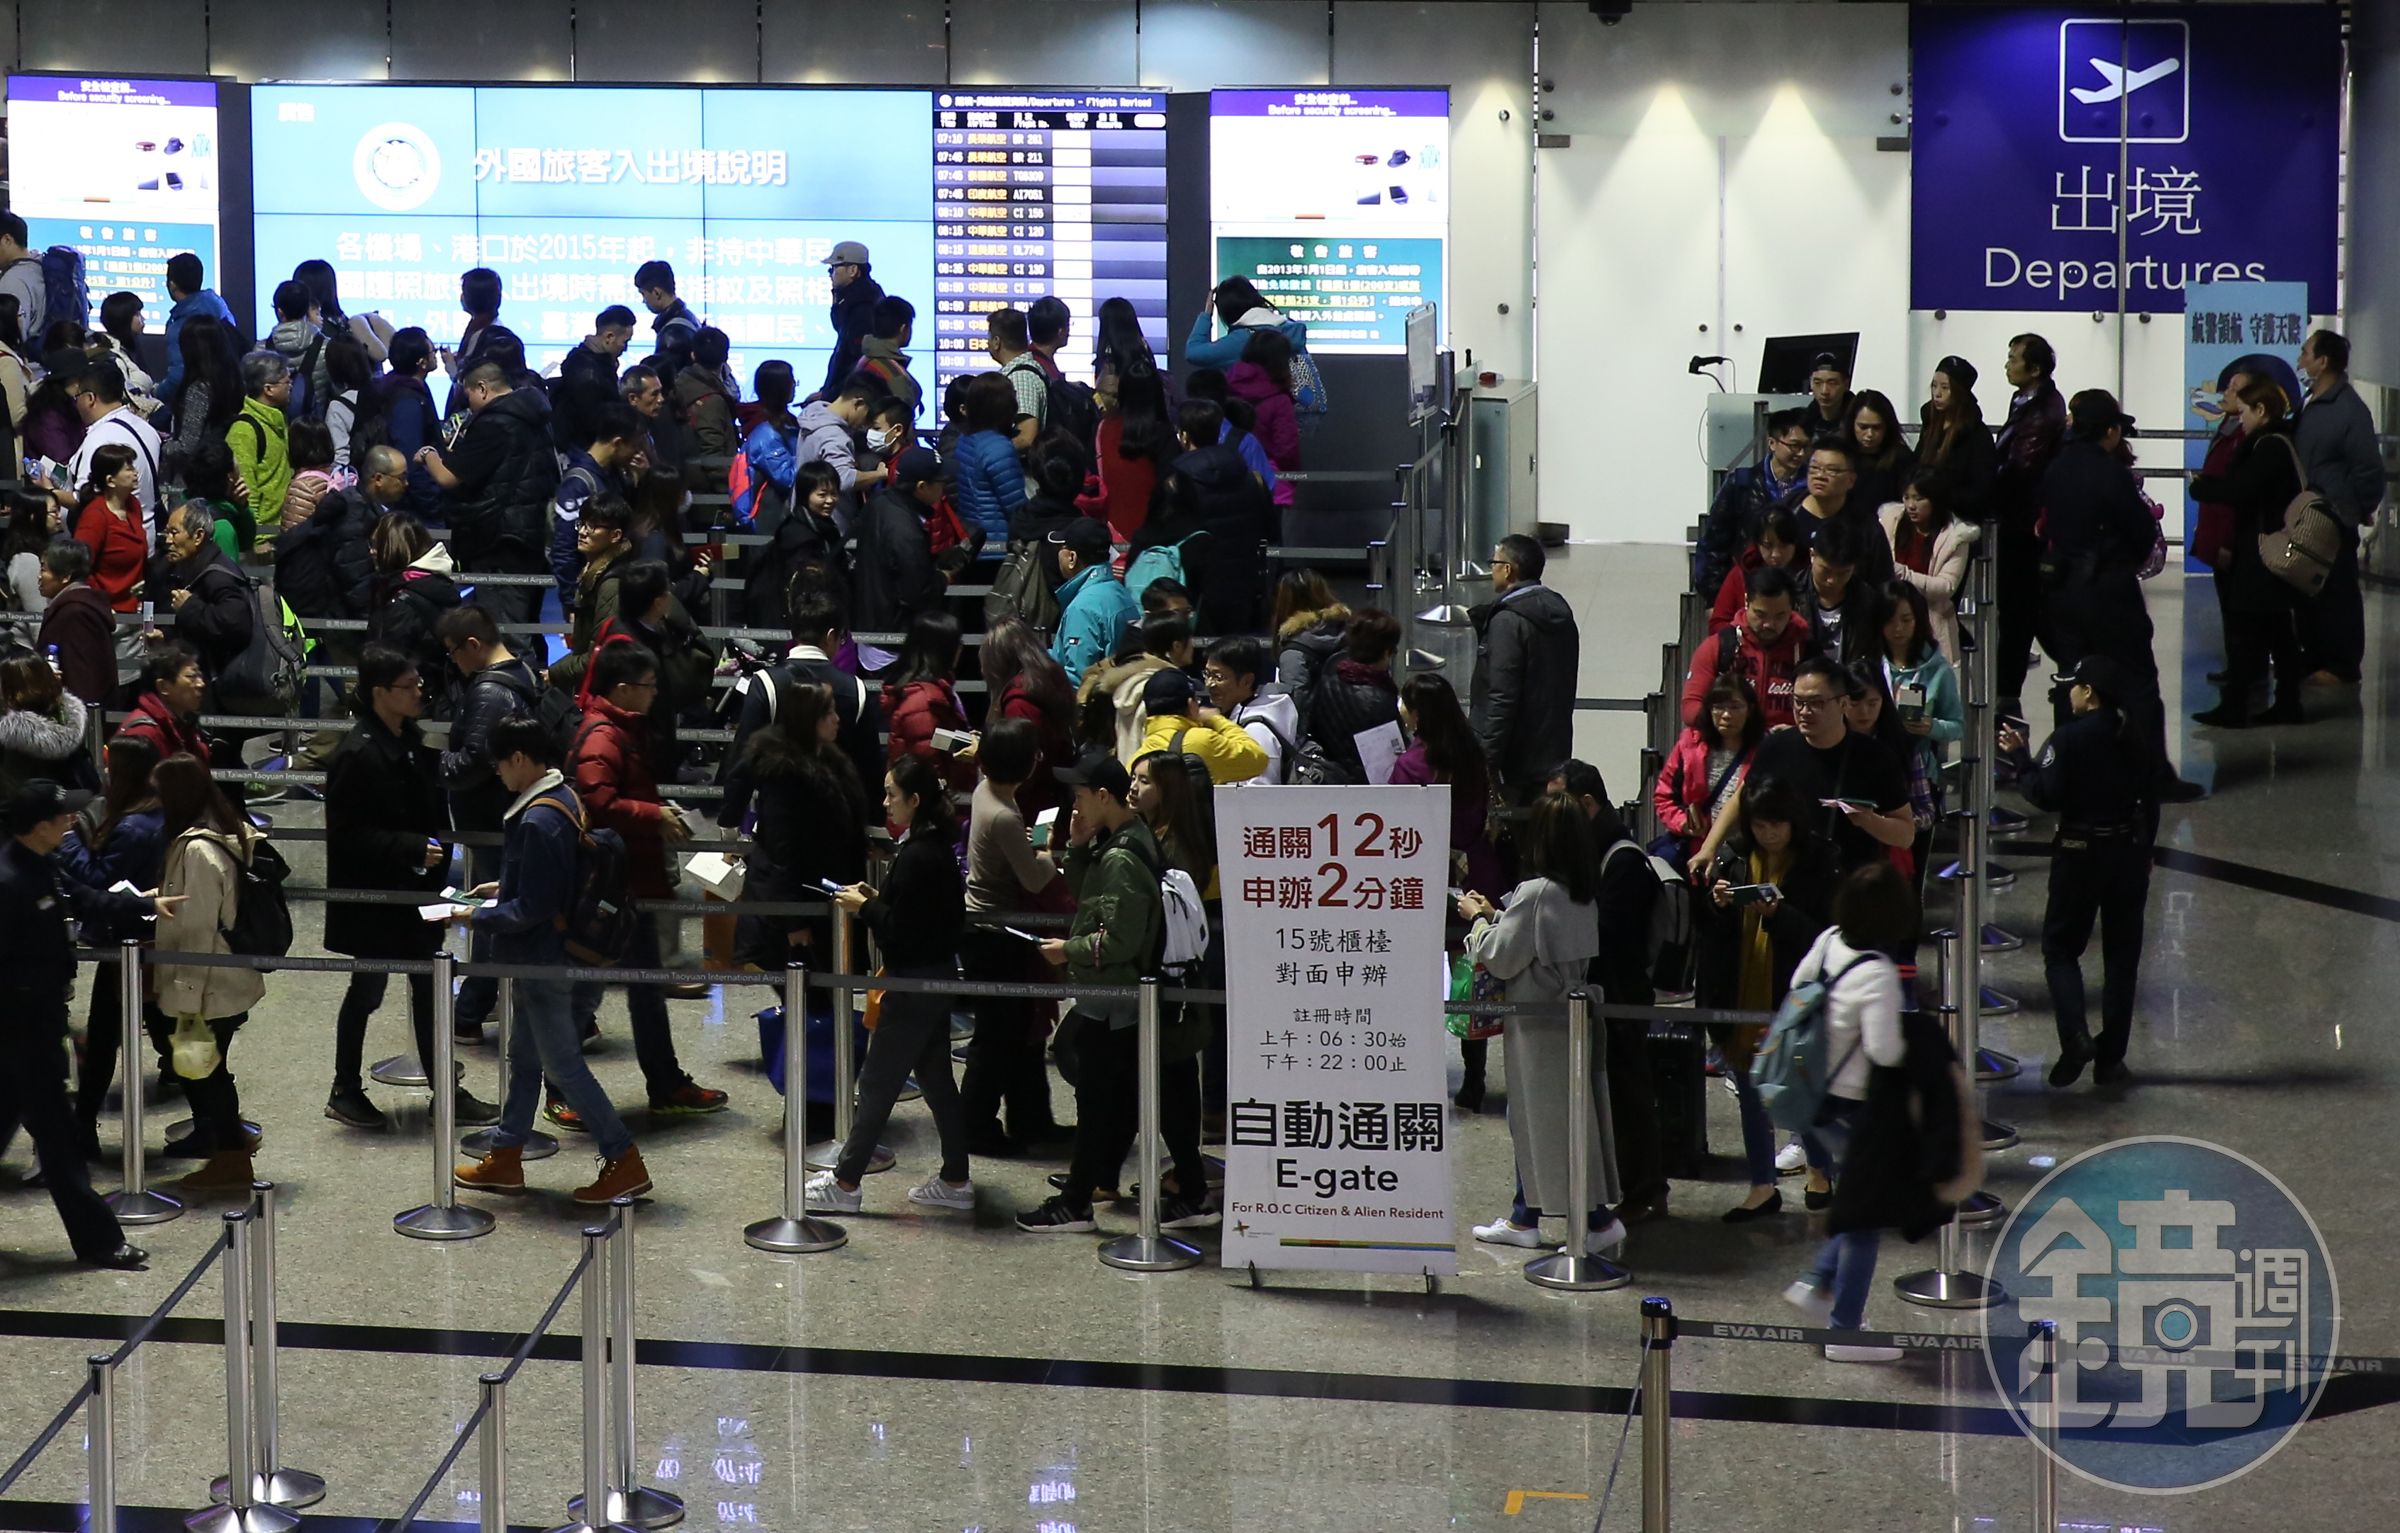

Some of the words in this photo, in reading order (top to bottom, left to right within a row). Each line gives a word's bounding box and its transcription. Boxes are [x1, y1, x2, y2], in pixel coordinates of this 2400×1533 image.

[58, 90, 87, 102] Before
[89, 92, 123, 104] security
[1268, 104, 1301, 115] Before
[1304, 105, 1340, 117] security
[938, 133, 963, 144] 07:10
[473, 146, 789, 188] 外國旅客入出境說明
[2051, 165, 2202, 237] 出境
[1013, 208, 1024, 218] CI
[1014, 226, 1025, 236] CI
[1014, 264, 1025, 275] CI
[1985, 247, 2267, 301] Departures
[1014, 283, 1025, 294] CI
[461, 574, 488, 583] Taoyuan
[488, 575, 529, 583] International
[530, 576, 553, 584] Airport
[262, 719, 286, 728] Taiwan
[288, 720, 316, 730] Taoyuan
[228, 770, 252, 779] Taiwan
[253, 771, 283, 782] Taoyuan
[286, 772, 326, 781] Internation
[1243, 812, 1423, 859] 通關12秒
[1243, 862, 1424, 910] 申辦2分鐘
[325, 960, 352, 969] Taiwan
[354, 961, 386, 972] Taoyuan
[389, 962, 433, 971] Internation
[641, 971, 669, 980] Taiwan
[671, 972, 705, 983] Taoyuan
[708, 973, 760, 982] International
[762, 975, 785, 984] Airpo
[1276, 961, 1388, 987] 對面申辦
[997, 984, 1027, 993] Taiwan
[1029, 986, 1063, 997] Taoyuan
[1066, 987, 1120, 996] International
[1121, 988, 1139, 998] Airp
[1485, 1004, 1517, 1014] Airport
[1293, 1007, 1371, 1025] 註冊時間
[1231, 1098, 1444, 1152] 自動通關
[1276, 1158, 1398, 1198] E-gate
[1232, 1202, 1253, 1213] For
[1256, 1203, 1292, 1215] R.O.C
[1295, 1204, 1337, 1216] Citizen
[1340, 1206, 1350, 1216] &
[1354, 1206, 1386, 1218] Alien
[1390, 1207, 1444, 1219] Resident
